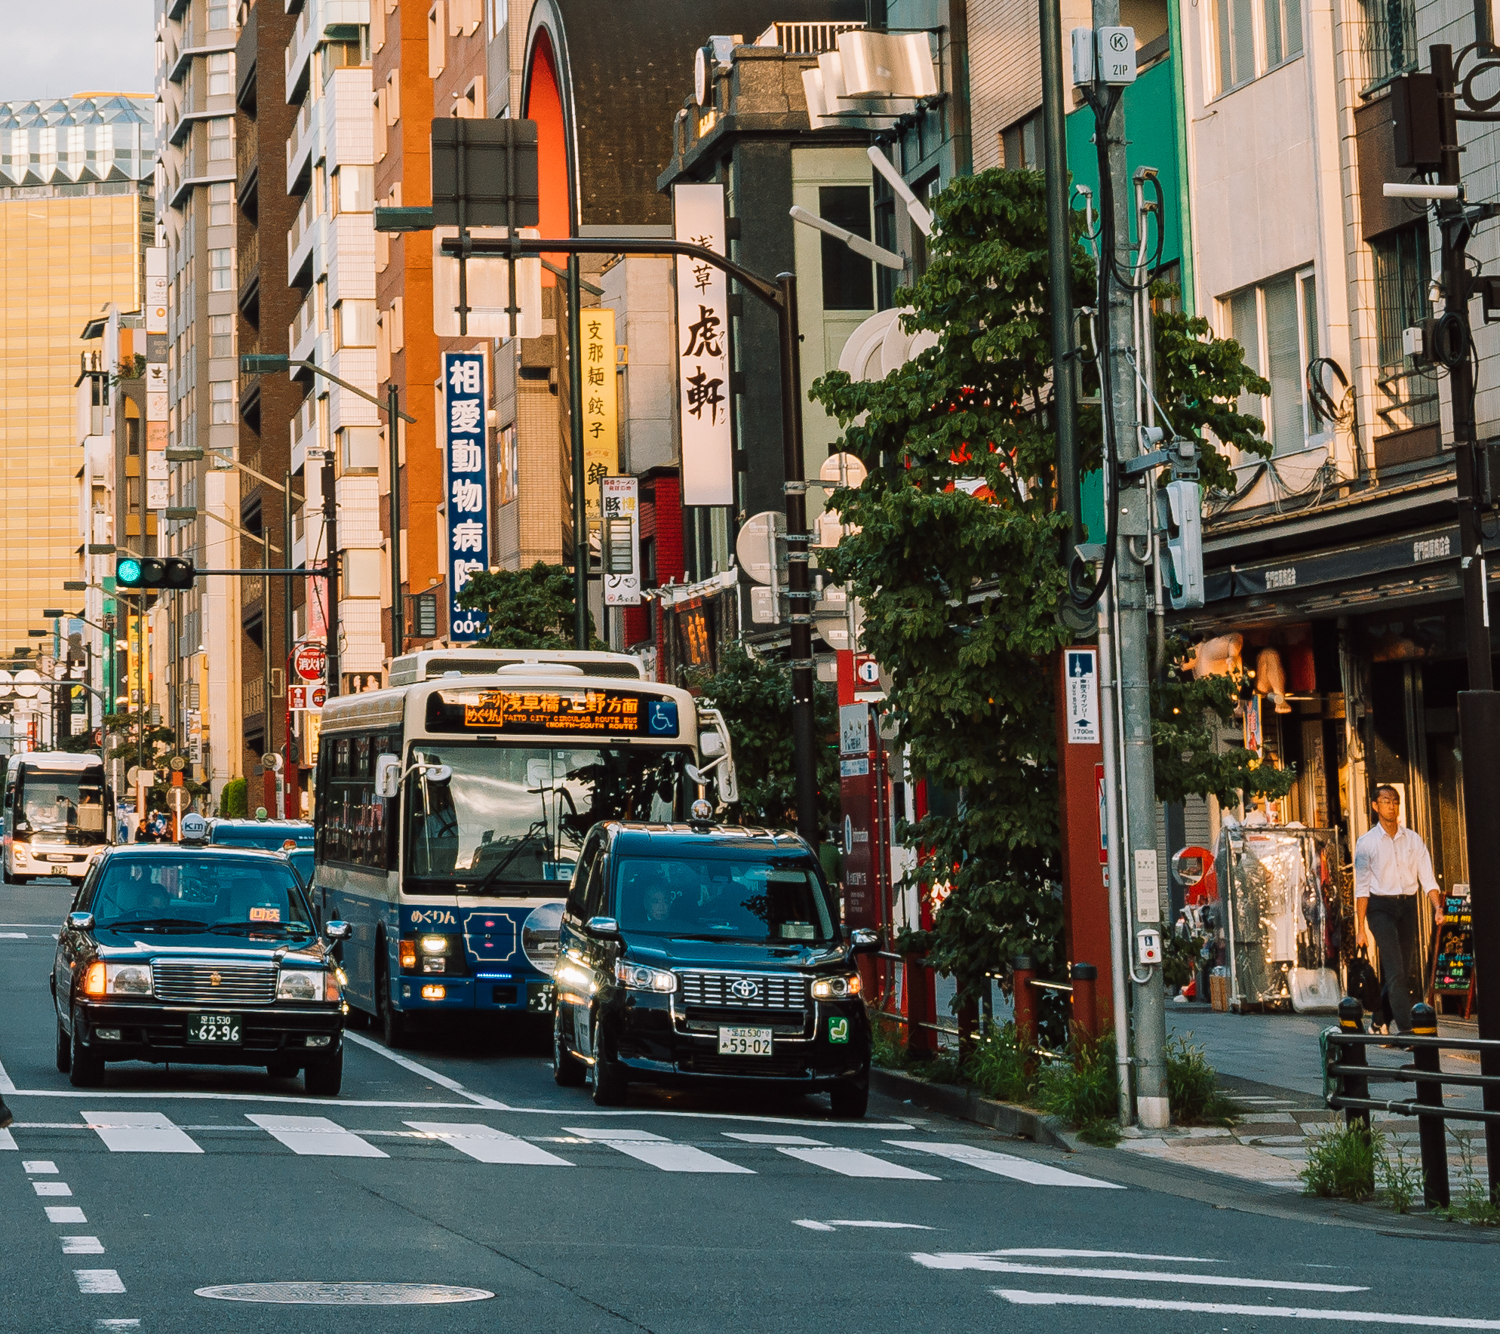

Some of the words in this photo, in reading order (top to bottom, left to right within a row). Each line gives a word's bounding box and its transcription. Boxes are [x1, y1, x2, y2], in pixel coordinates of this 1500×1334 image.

[411, 910, 457, 925] めぐりん
[199, 1025, 240, 1041] 62-96
[730, 1038, 771, 1055] 59-02
